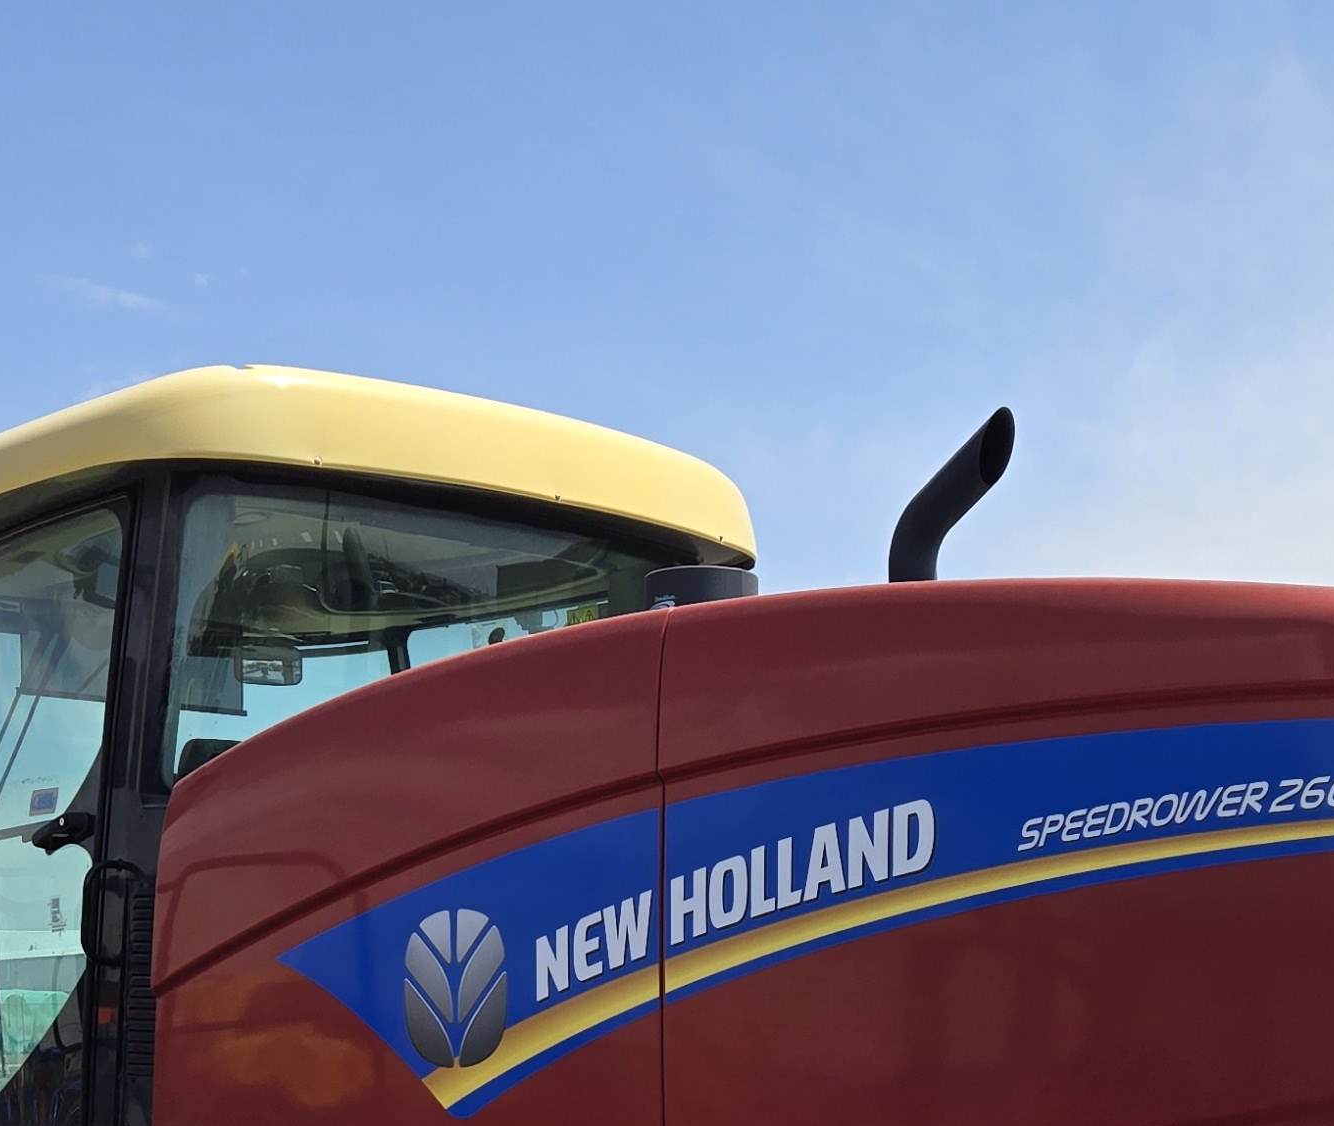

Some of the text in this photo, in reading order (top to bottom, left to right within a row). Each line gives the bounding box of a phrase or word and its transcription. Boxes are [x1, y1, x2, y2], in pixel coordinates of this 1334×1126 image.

[1017, 781, 1268, 852] SPEEDROWER
[535, 798, 936, 1002] NEW HOLLAND
